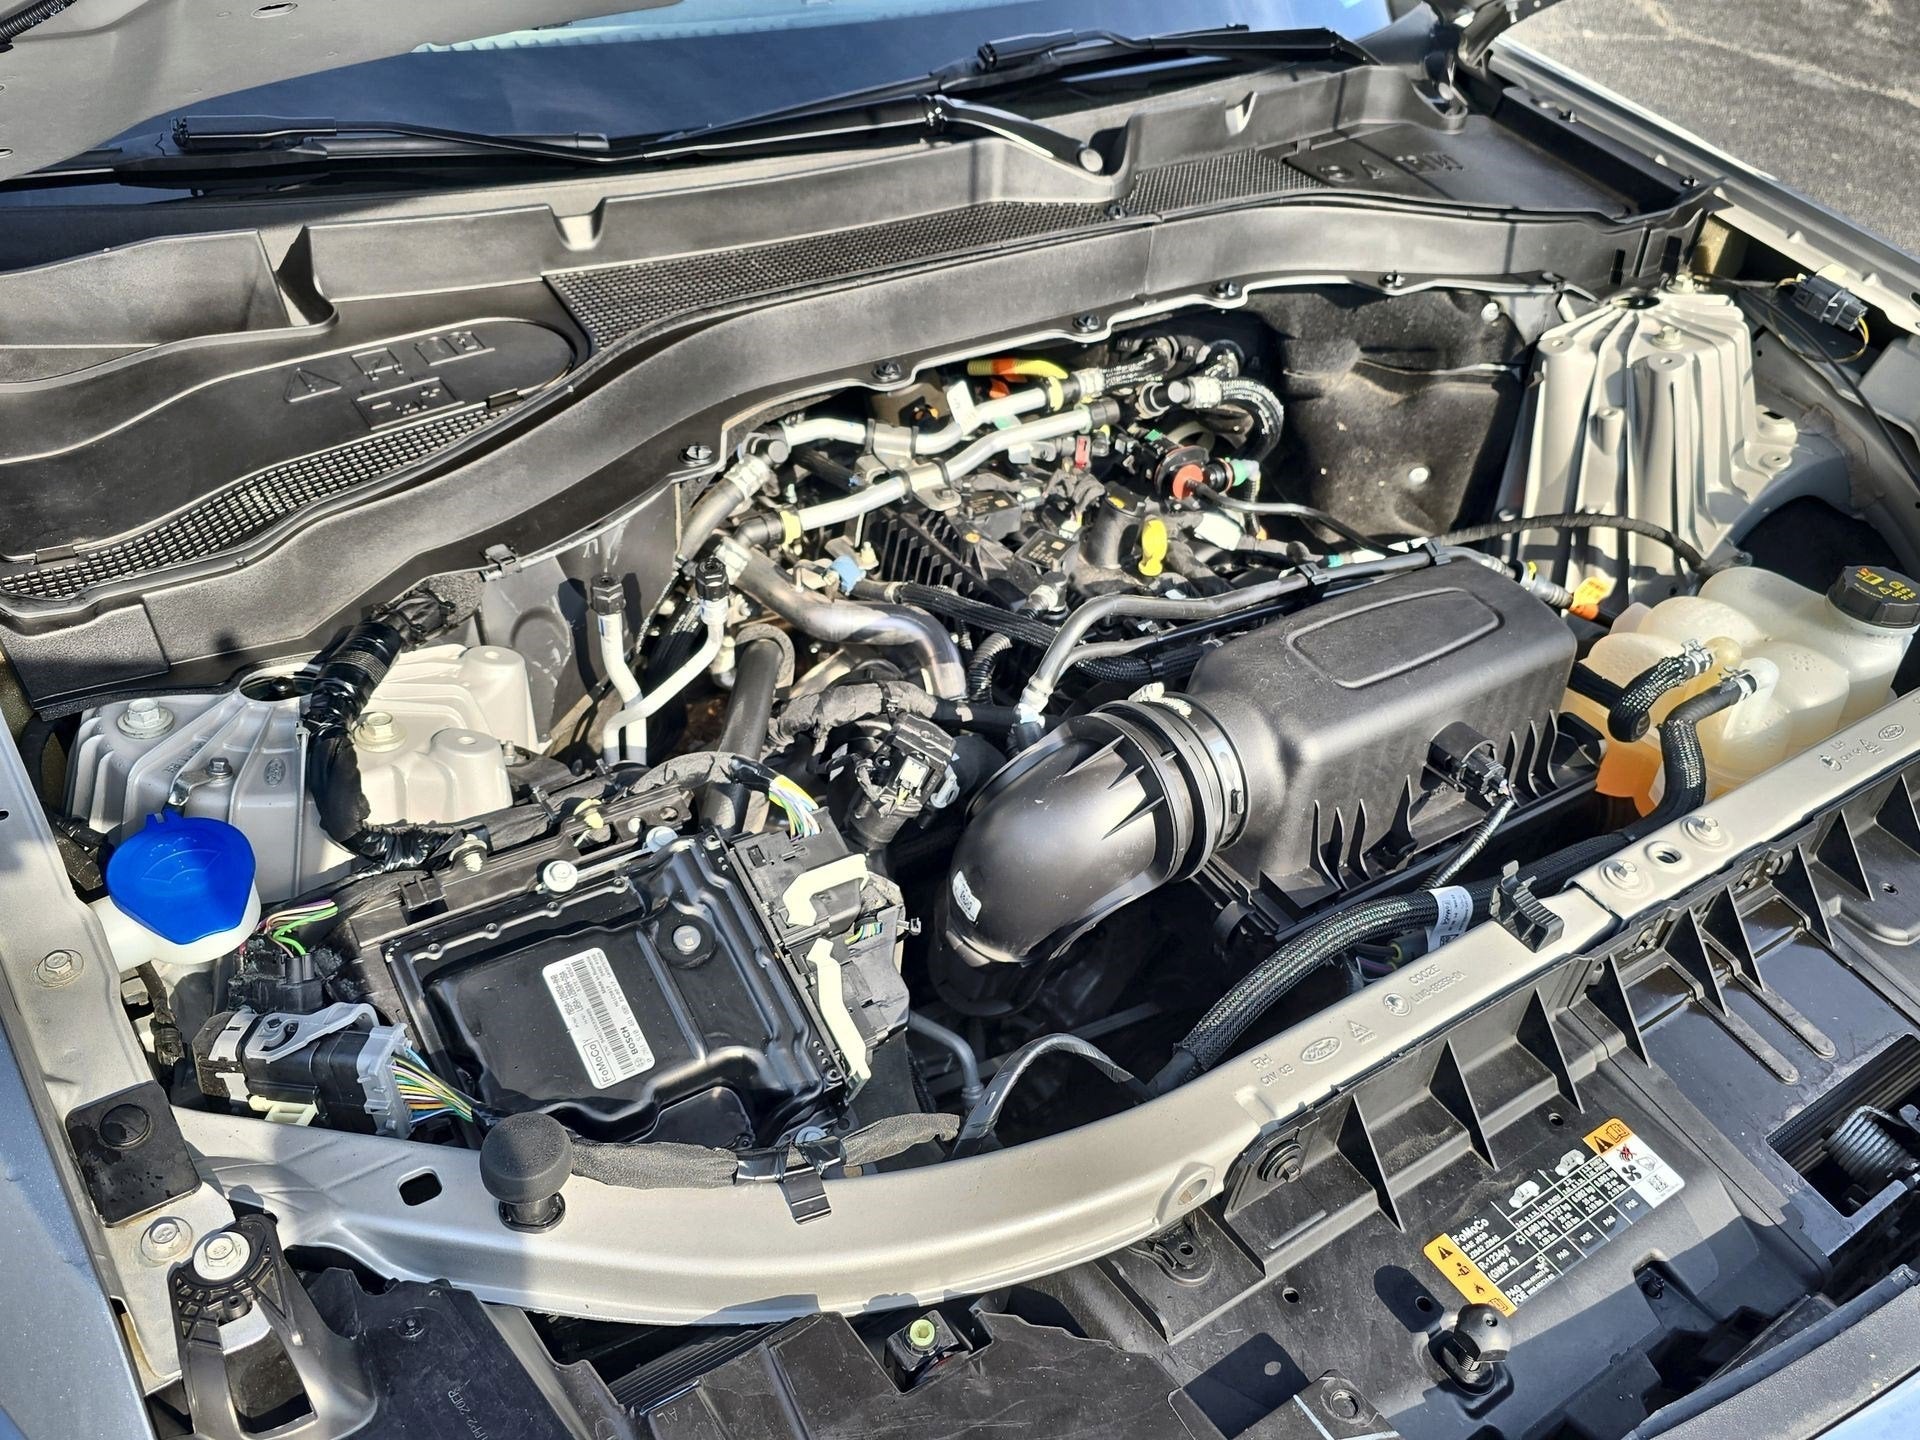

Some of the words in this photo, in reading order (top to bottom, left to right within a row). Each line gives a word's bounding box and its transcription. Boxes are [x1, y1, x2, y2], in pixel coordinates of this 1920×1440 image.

[620, 1026, 639, 1055] BOSCH
[589, 1044, 611, 1083] FoMoCo
[1251, 1054, 1274, 1071] RH
[1625, 1199, 1638, 1210] POE
[1603, 1215, 1616, 1226] PAG
[1452, 1219, 1489, 1245] FoMoCo
[1580, 1232, 1593, 1243] POE
[1477, 1244, 1511, 1271] R-1234yf
[1556, 1249, 1570, 1260] PAG
[1487, 1261, 1509, 1282] (GWP
[1508, 1256, 1520, 1266] 4)
[1505, 1284, 1522, 1299] PAG
[1511, 1290, 1529, 1306] POE
[656, 1408, 678, 1425] AL
